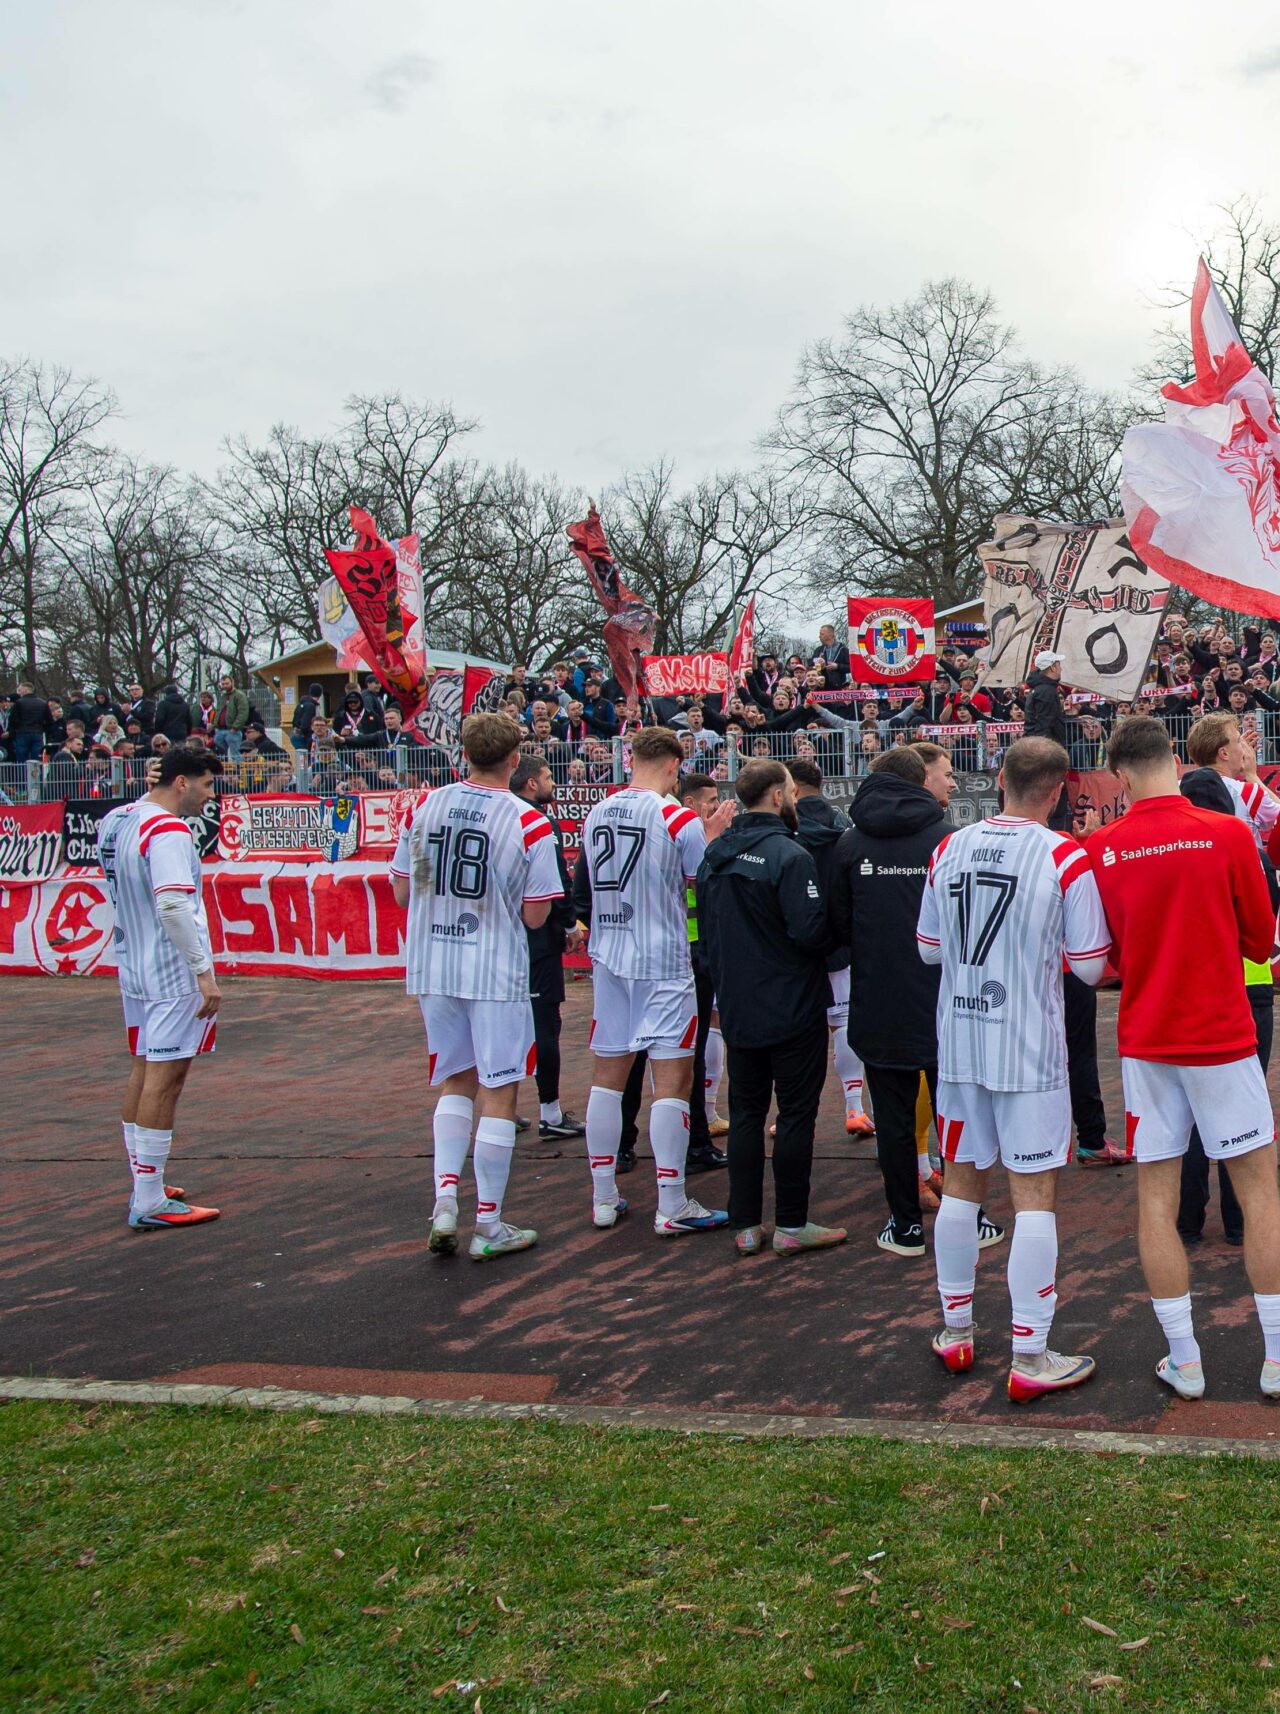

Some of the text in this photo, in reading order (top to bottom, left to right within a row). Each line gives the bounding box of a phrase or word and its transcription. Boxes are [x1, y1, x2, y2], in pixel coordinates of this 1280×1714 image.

[251, 805, 323, 829] SEKTION
[448, 807, 487, 825] EHRLICH
[240, 829, 336, 850] WEISSENFELS
[592, 824, 647, 893] 27
[970, 848, 1006, 864] KULKE
[1121, 838, 1214, 862] Saalesparkasse
[428, 825, 490, 901] 18
[949, 871, 1019, 967] 17
[432, 923, 466, 938] muth
[953, 993, 990, 1013] muth
[153, 1046, 181, 1054] PATRICK
[492, 1067, 518, 1079] PATRICK
[1231, 1128, 1260, 1145] PATRICK
[1021, 1150, 1054, 1162] PATRICK
